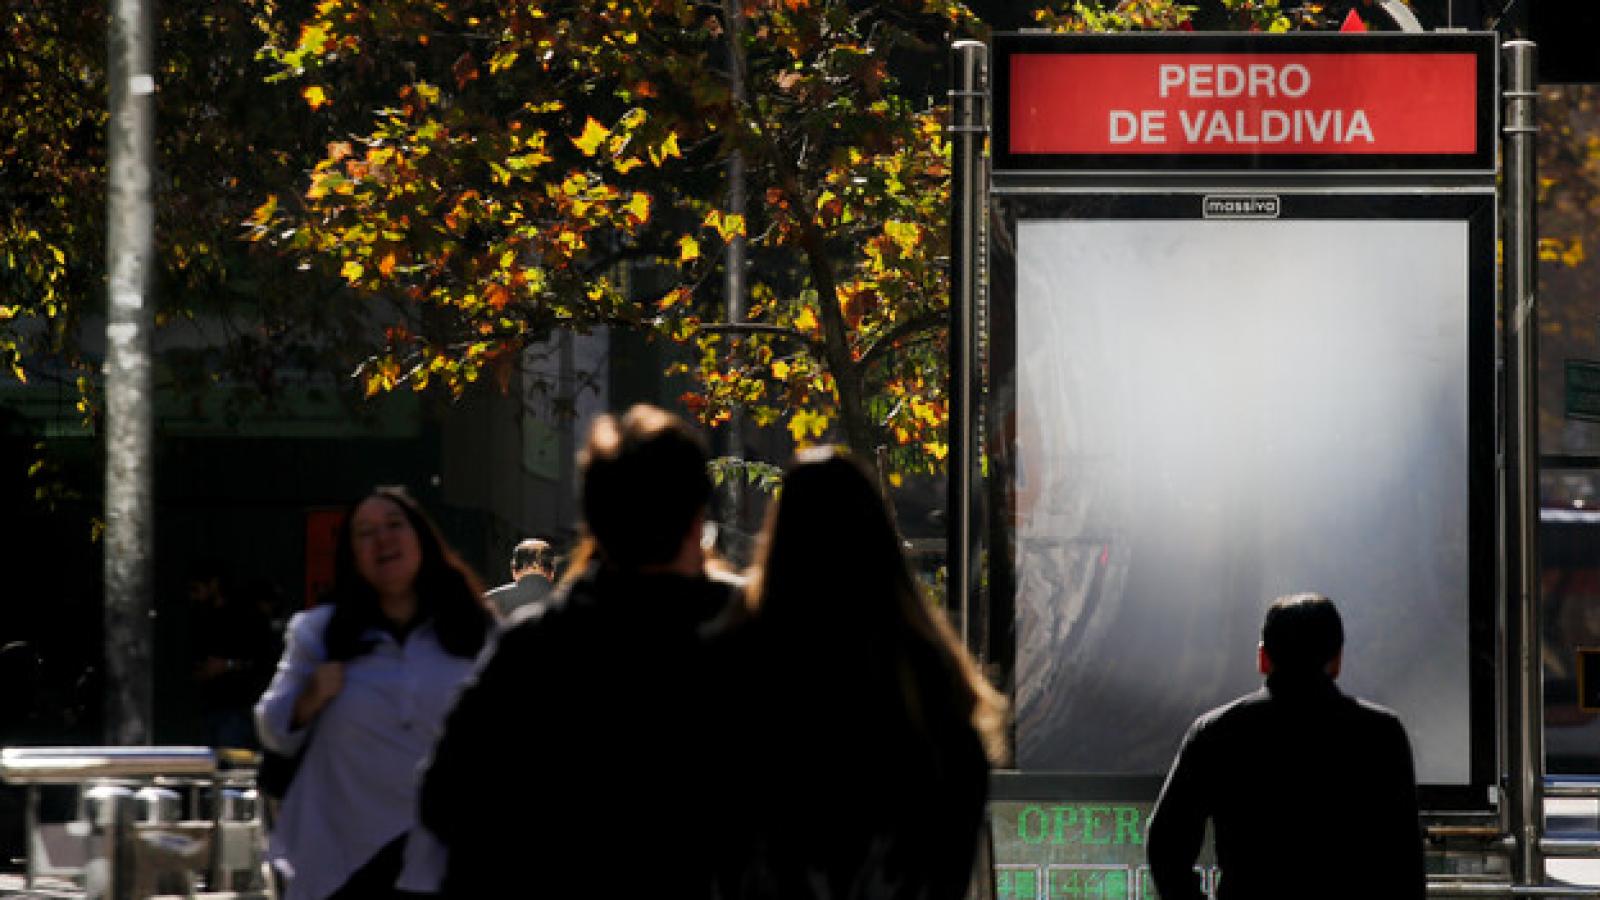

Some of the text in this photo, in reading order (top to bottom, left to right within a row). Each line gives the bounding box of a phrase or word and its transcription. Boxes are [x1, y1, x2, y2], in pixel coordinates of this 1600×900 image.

[1158, 63, 1311, 98] PEDRO
[1109, 109, 1375, 144] DE VALDIVIA
[1017, 805, 1150, 845] OPER
